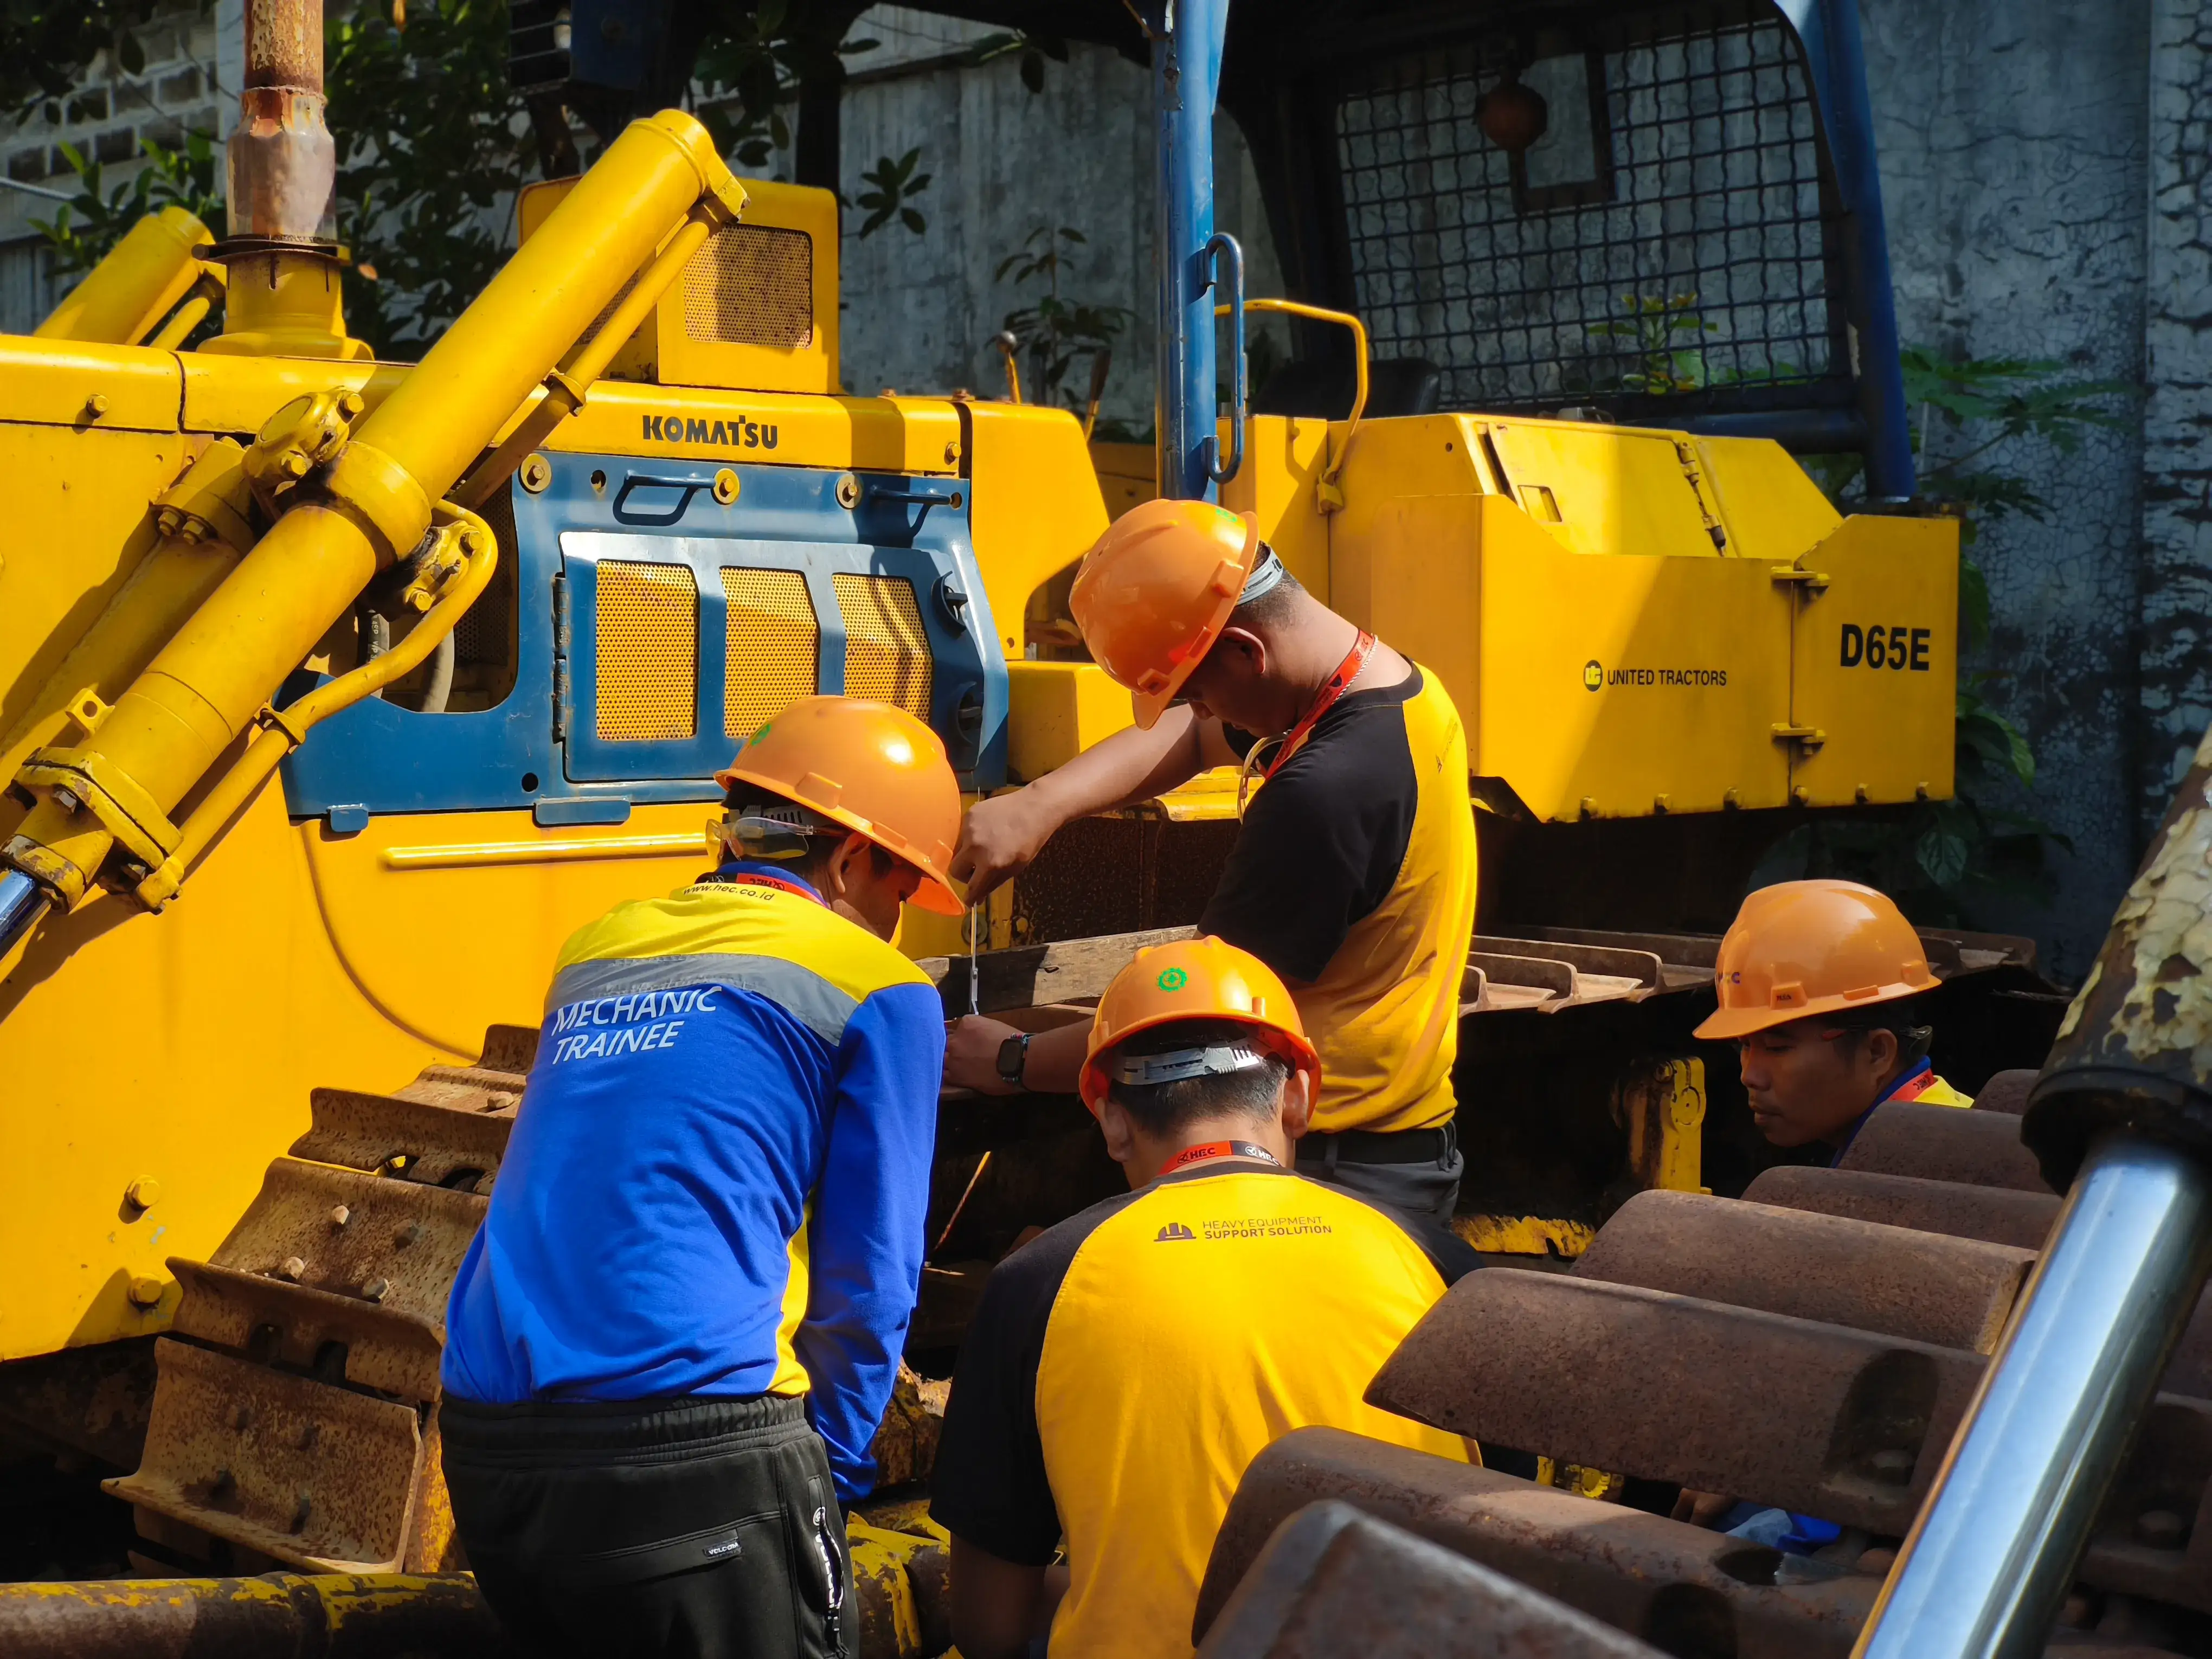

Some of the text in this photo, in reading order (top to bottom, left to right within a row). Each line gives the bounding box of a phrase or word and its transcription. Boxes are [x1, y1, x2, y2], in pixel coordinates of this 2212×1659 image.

[642, 415, 778, 449] KOMATSU
[1841, 624, 1931, 671] D65E
[1607, 669, 1727, 686] UNITED TRACTORS
[684, 884, 775, 901] www.hec.co.id
[551, 986, 722, 1037] MECHANIC
[552, 1020, 685, 1065] TRAINEE
[1190, 1147, 1216, 1160] HEC
[1257, 1149, 1280, 1166] HEC
[1203, 1216, 1323, 1229] HEAVY EQUIPMENT
[1205, 1225, 1332, 1239] SUPPORT SOLUTION
[709, 1542, 738, 1555] VOLCOM
